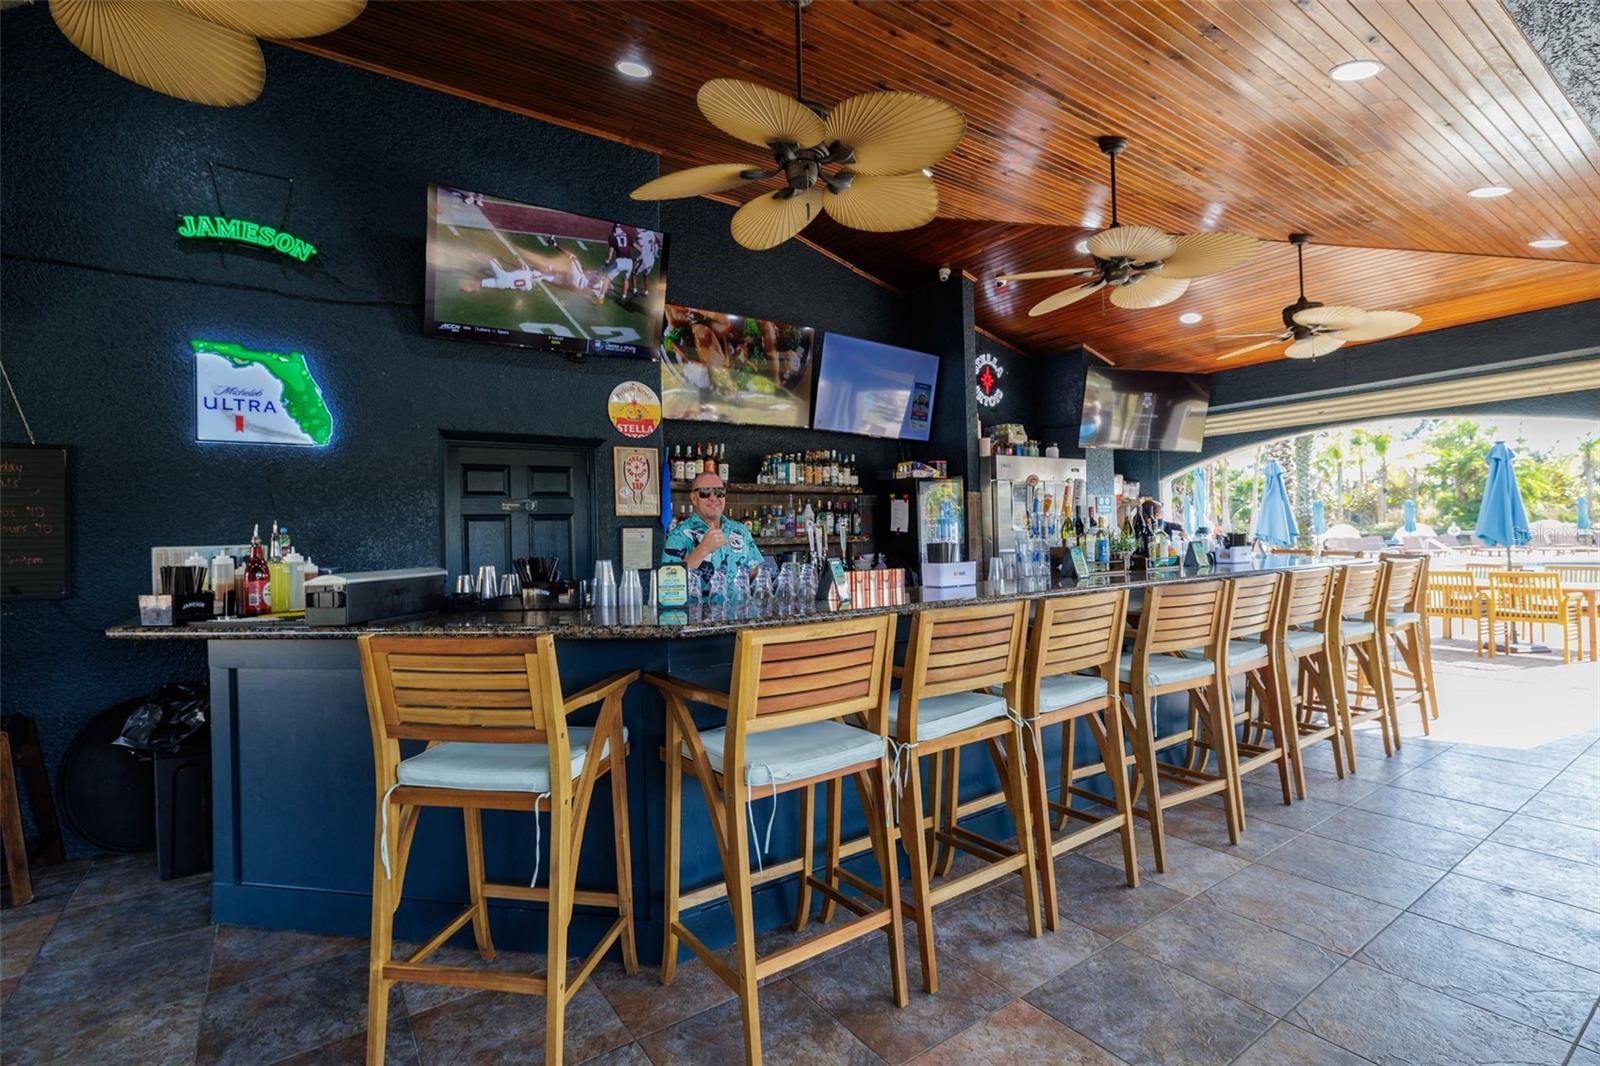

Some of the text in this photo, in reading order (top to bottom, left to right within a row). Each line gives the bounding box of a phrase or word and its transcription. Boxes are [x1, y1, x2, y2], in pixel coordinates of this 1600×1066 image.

[177, 215, 317, 262] JAMESON
[213, 385, 264, 397] Michelob
[203, 396, 277, 414] ULTRA
[616, 423, 654, 435] STELLA
[631, 482, 644, 490] TAP
